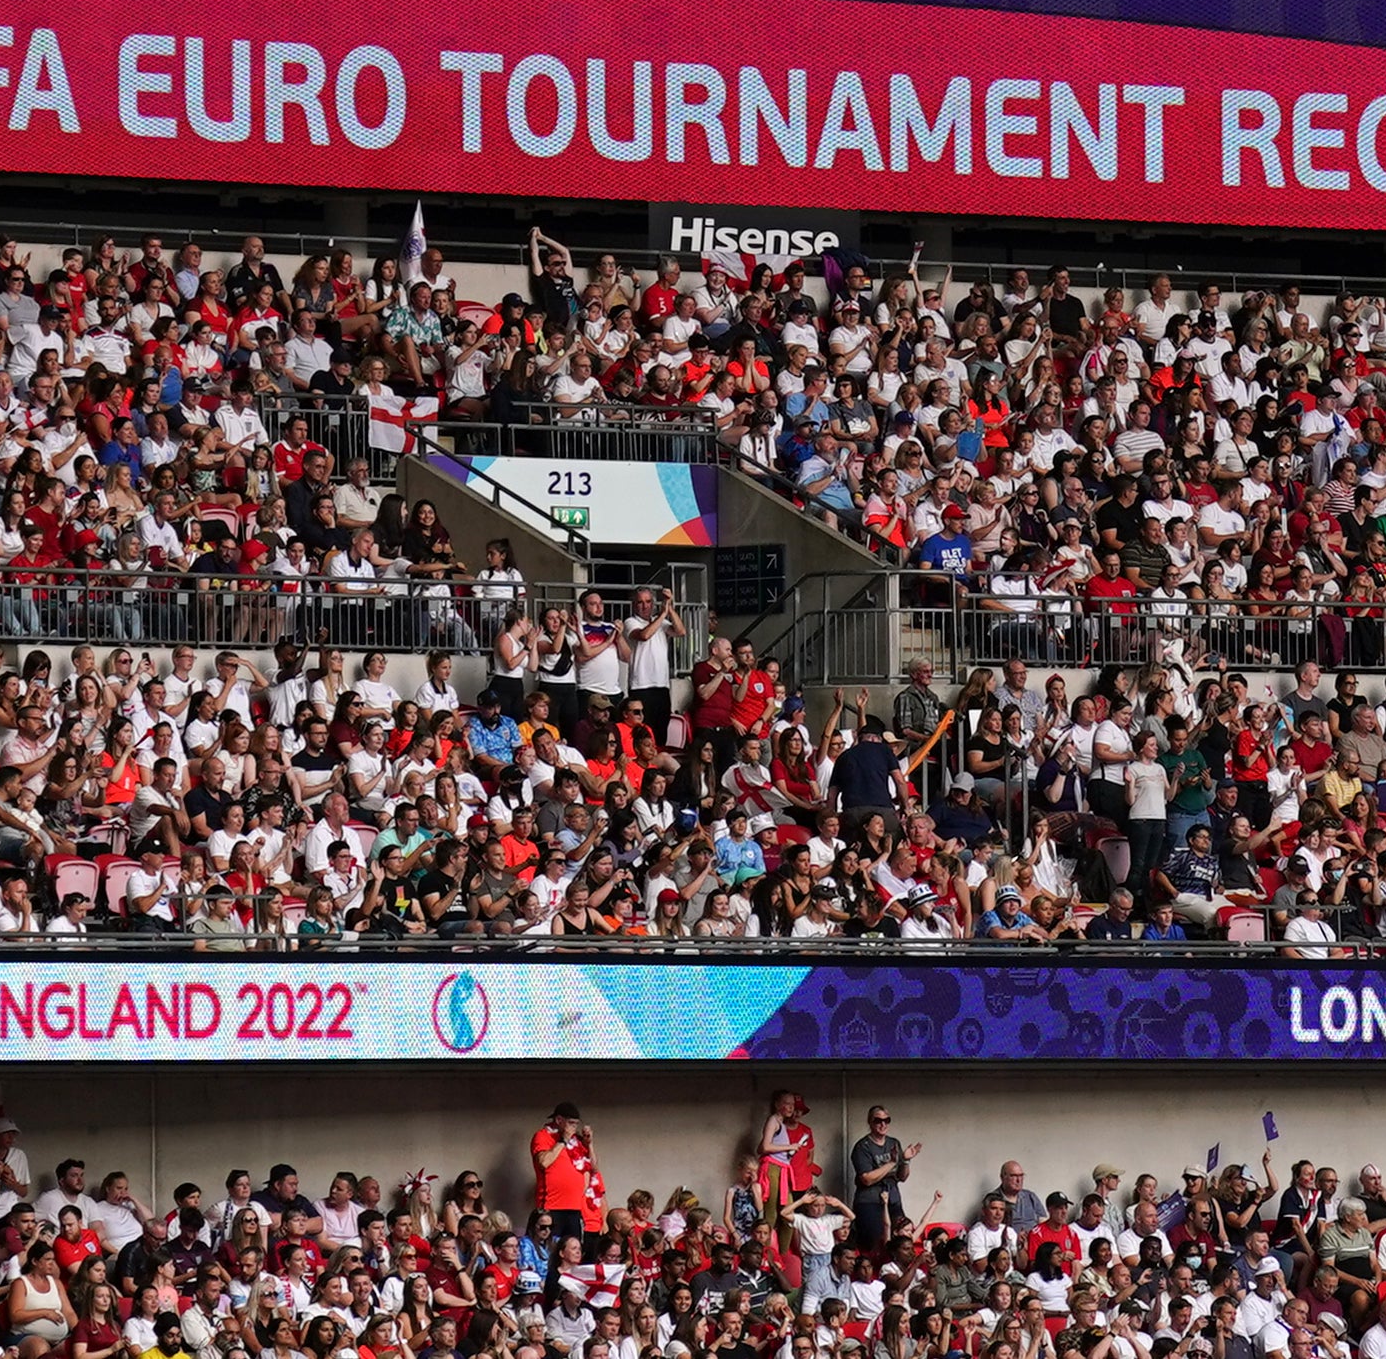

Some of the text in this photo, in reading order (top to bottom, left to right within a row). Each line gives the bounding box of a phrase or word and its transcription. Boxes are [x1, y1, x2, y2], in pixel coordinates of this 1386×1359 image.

[118, 34, 407, 150] EURO
[440, 51, 1186, 183] TOURNAMENT
[669, 216, 840, 257] Hisense
[547, 471, 592, 496] 213
